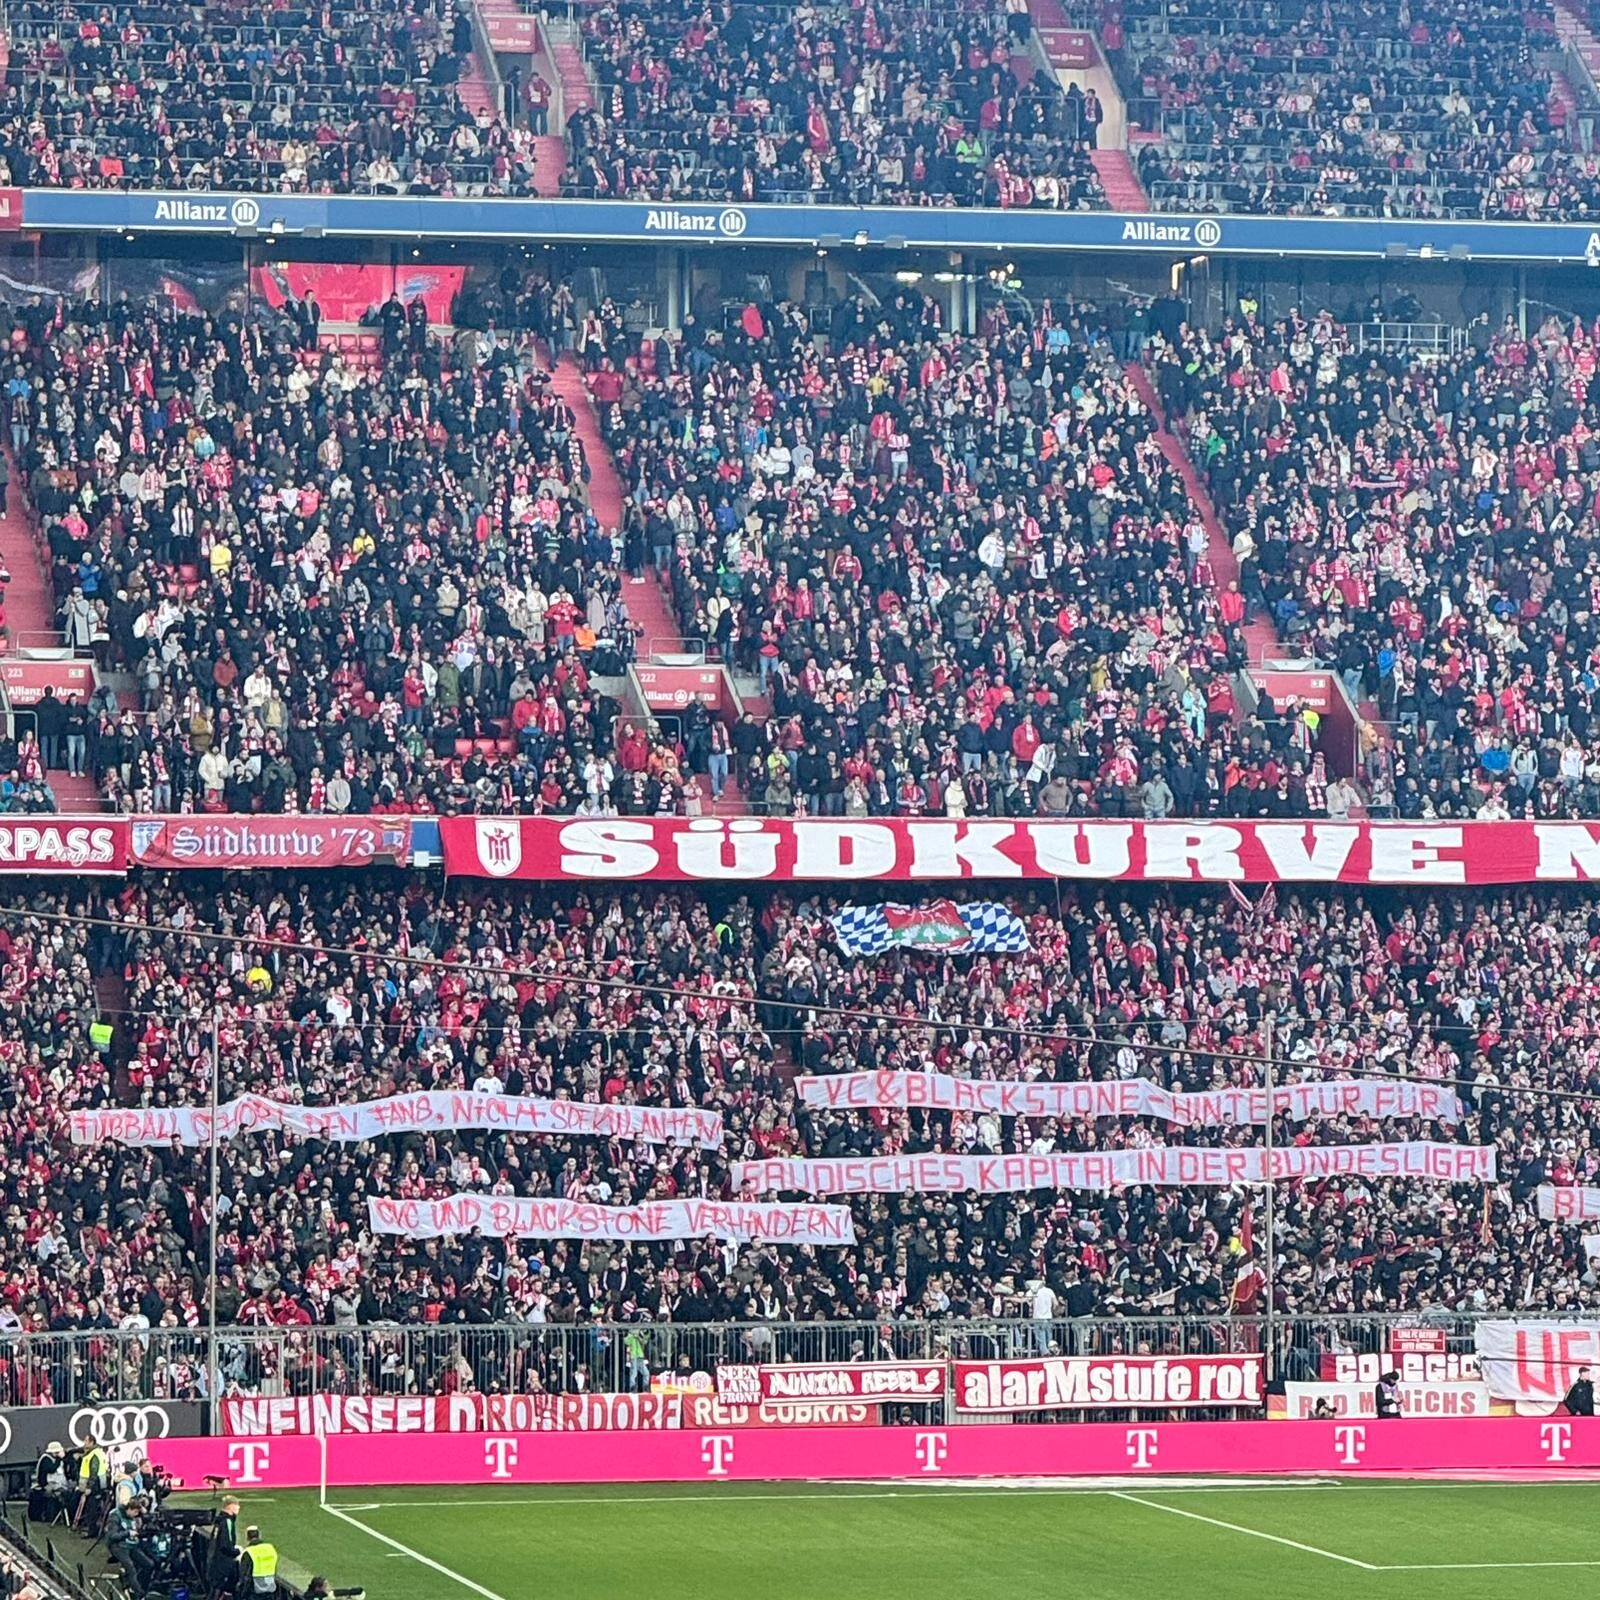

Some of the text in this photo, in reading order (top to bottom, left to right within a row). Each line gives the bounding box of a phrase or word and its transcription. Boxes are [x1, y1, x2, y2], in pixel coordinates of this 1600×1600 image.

[154, 200, 227, 221] Allianz
[645, 210, 716, 230] Allianz
[1122, 221, 1191, 241] Allianz
[640, 673, 656, 683] 222
[8, 685, 41, 697] Allianz
[688, 691, 716, 701] Ana
[171, 825, 376, 857] Südkurve '73
[559, 819, 1466, 883] SÜDKURVE
[906, 1074, 1139, 1114] BLACKSTONE
[1376, 1085, 1439, 1116] FÜR
[743, 1145, 1488, 1194] SAUDISCHES KAPITAL IN DER BUNDESLIGA!
[1554, 1189, 1598, 1219] BL
[431, 1198, 481, 1231] UND
[490, 1199, 672, 1234] BLACKSTONE
[717, 1365, 760, 1380] SEEN
[965, 1360, 1260, 1407] alarMstufe rot
[718, 1380, 761, 1392] LAND
[1298, 1394, 1348, 1417] RD
